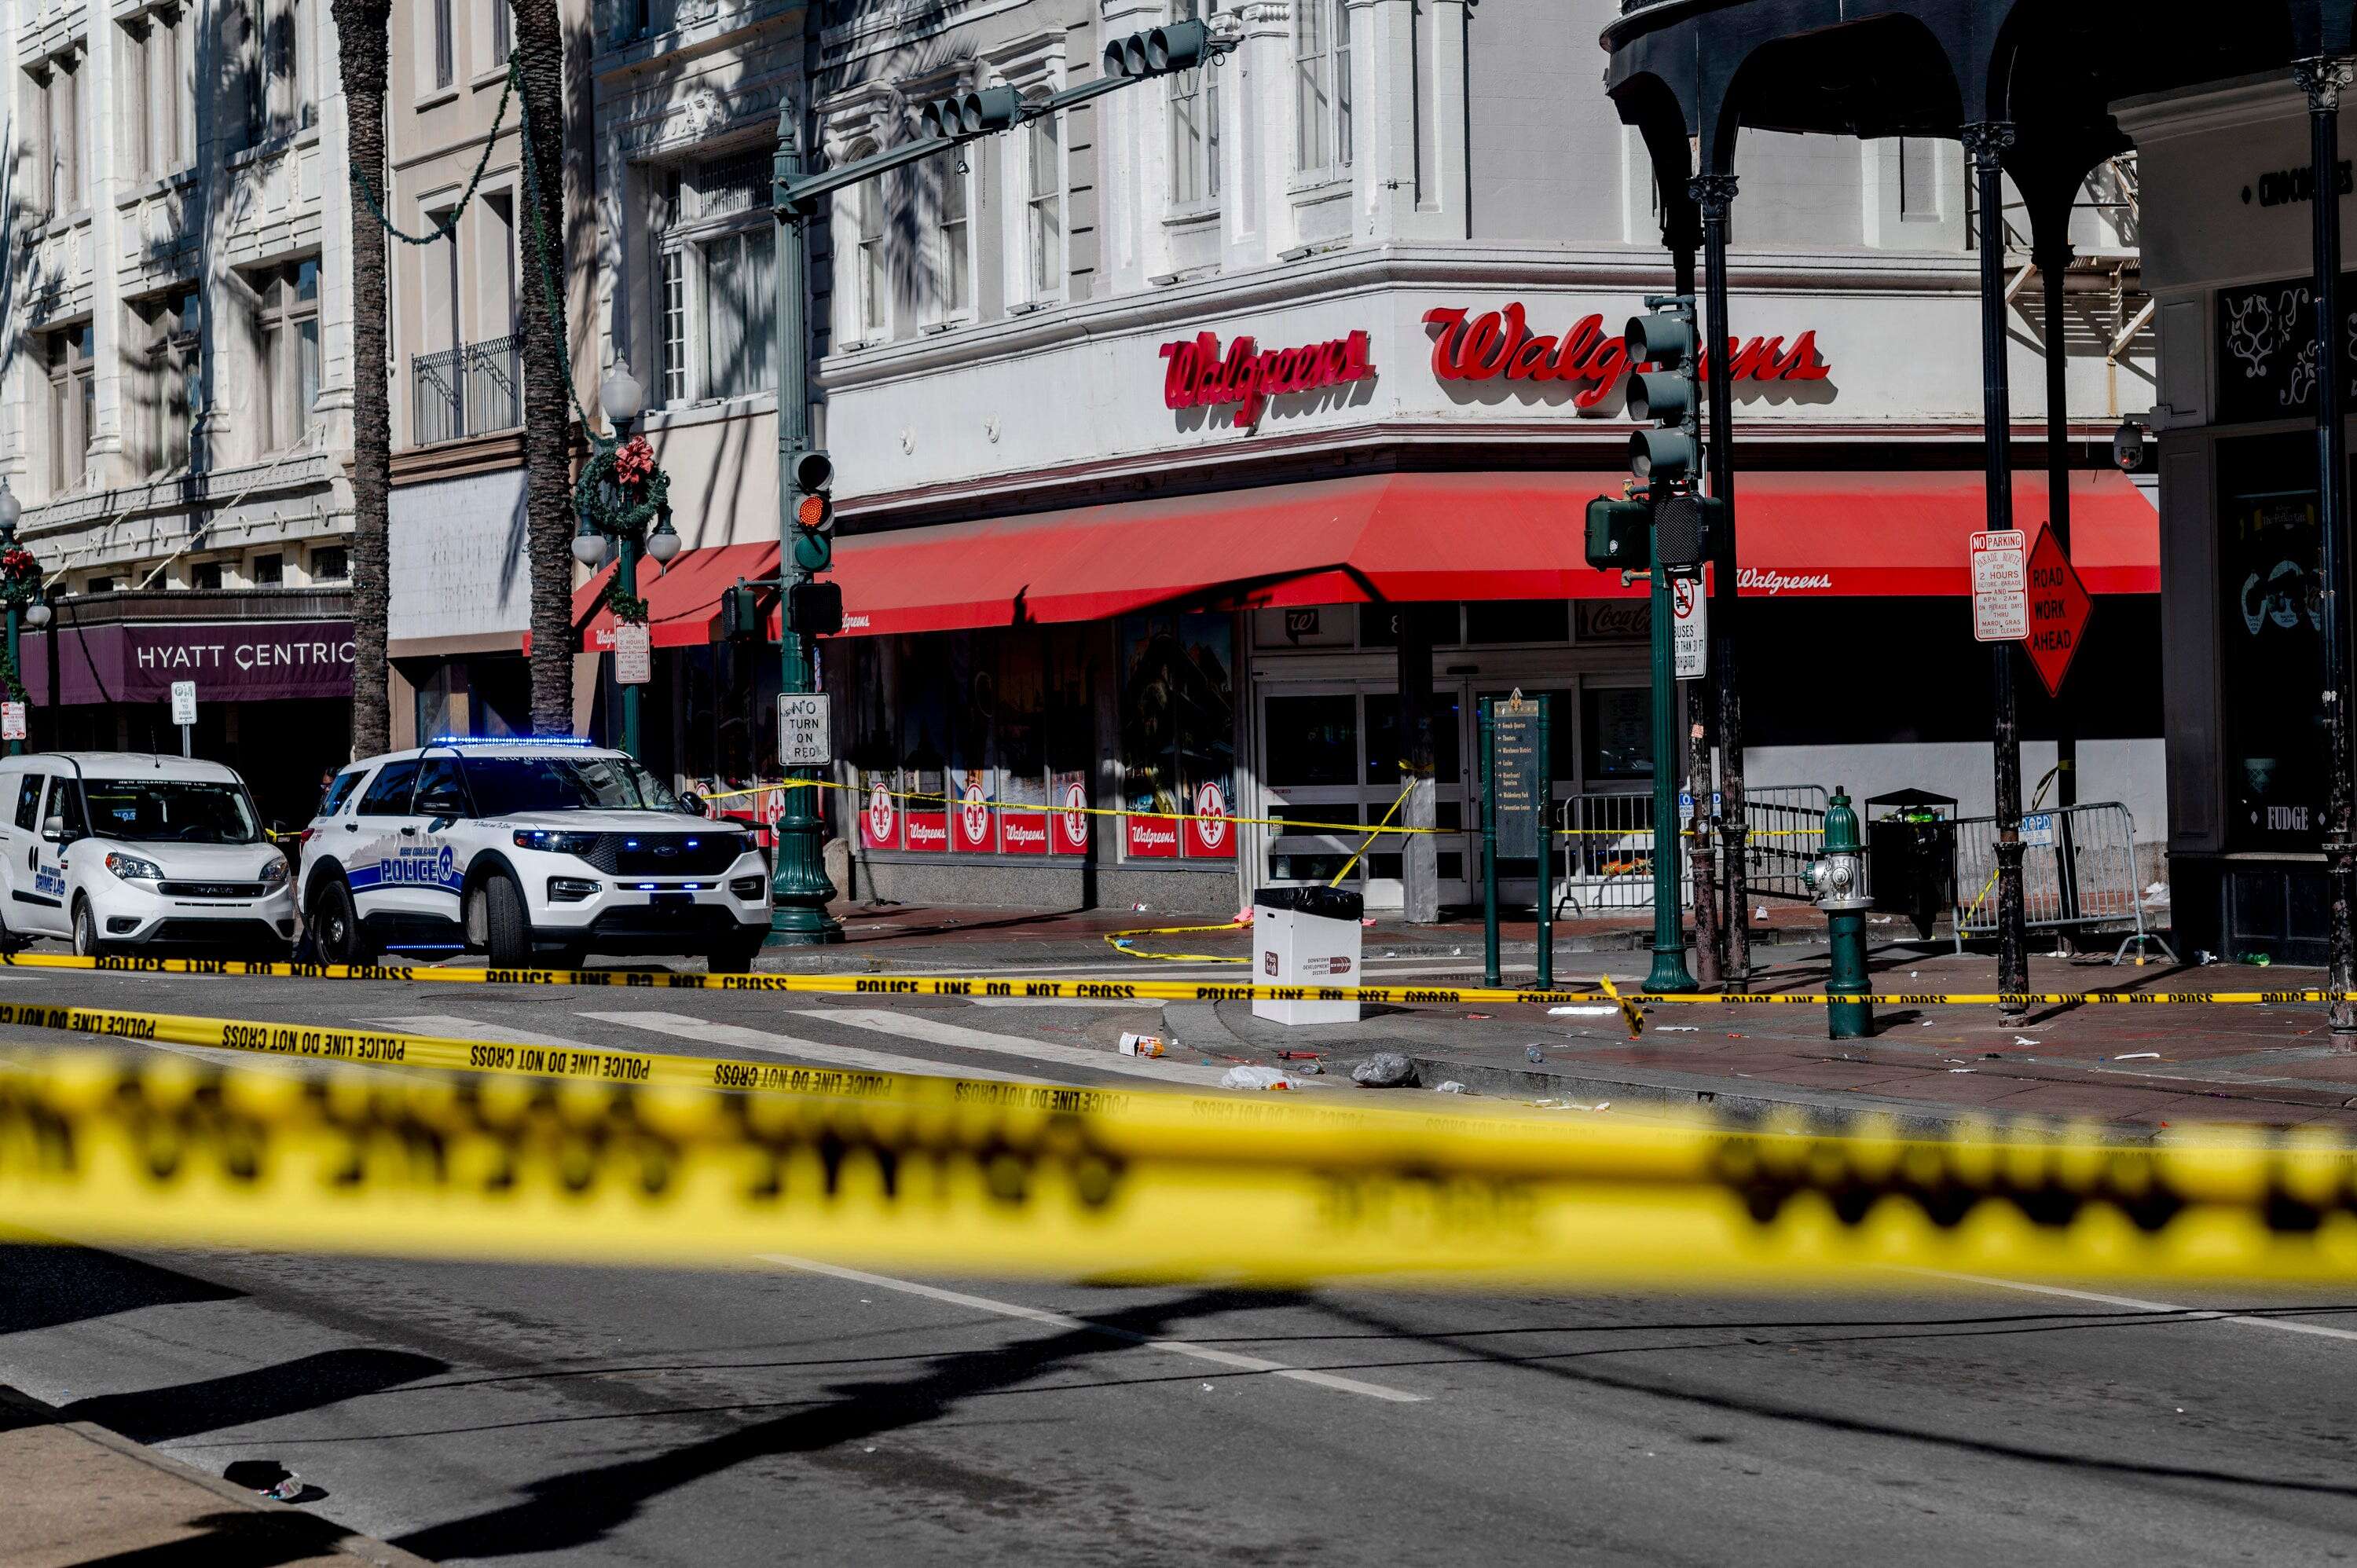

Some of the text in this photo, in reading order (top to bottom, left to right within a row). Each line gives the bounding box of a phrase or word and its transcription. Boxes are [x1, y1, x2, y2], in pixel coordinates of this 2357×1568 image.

[1159, 330, 1376, 427] Walgreens
[1973, 536, 2020, 549] NO PARKING
[1736, 567, 1832, 595] Walgreens
[1990, 570, 2019, 580] HOURS
[2033, 566, 2063, 588] ROAD
[2035, 599, 2066, 620] WORK
[1681, 640, 1692, 652] THAN
[1699, 639, 1703, 650] FT
[2033, 630, 2071, 652] AHEAD
[137, 646, 225, 668] HYATT
[793, 702, 816, 715] NO
[790, 719, 819, 729] TURN
[797, 733, 812, 742] ON
[794, 748, 816, 757] RED
[2267, 806, 2308, 830] FUDGE
[910, 823, 946, 844] Walgreens
[1006, 824, 1046, 845] Walgreens
[1132, 825, 1175, 848] Walgreens
[412, 846, 439, 857] ORLEANS
[380, 858, 440, 884] POLICE
[35, 874, 65, 897] CRIME LAB
[96, 956, 164, 970] POLICE
[185, 959, 226, 973] LINE
[347, 965, 413, 980] CROSS
[486, 971, 553, 984] POLICE
[570, 973, 611, 985] LINE
[669, 976, 706, 988] NOT
[722, 976, 787, 991] CROSS
[856, 980, 1135, 998] POLICE LINE DO NOT CROSS
[1197, 987, 1255, 1000] POLICE
[17, 1008, 46, 1026] NOT
[48, 1010, 68, 1030] DO
[72, 1013, 104, 1034] LINE
[108, 1016, 156, 1039] POLICE
[222, 1024, 406, 1061] POLICE LINE DO NOT CROSS
[470, 1045, 651, 1080] POLICE LINE DO NOT CROSS
[713, 1064, 893, 1097] POLICE LINE DO NOT CROSS
[1050, 1090, 1080, 1112] LINE
